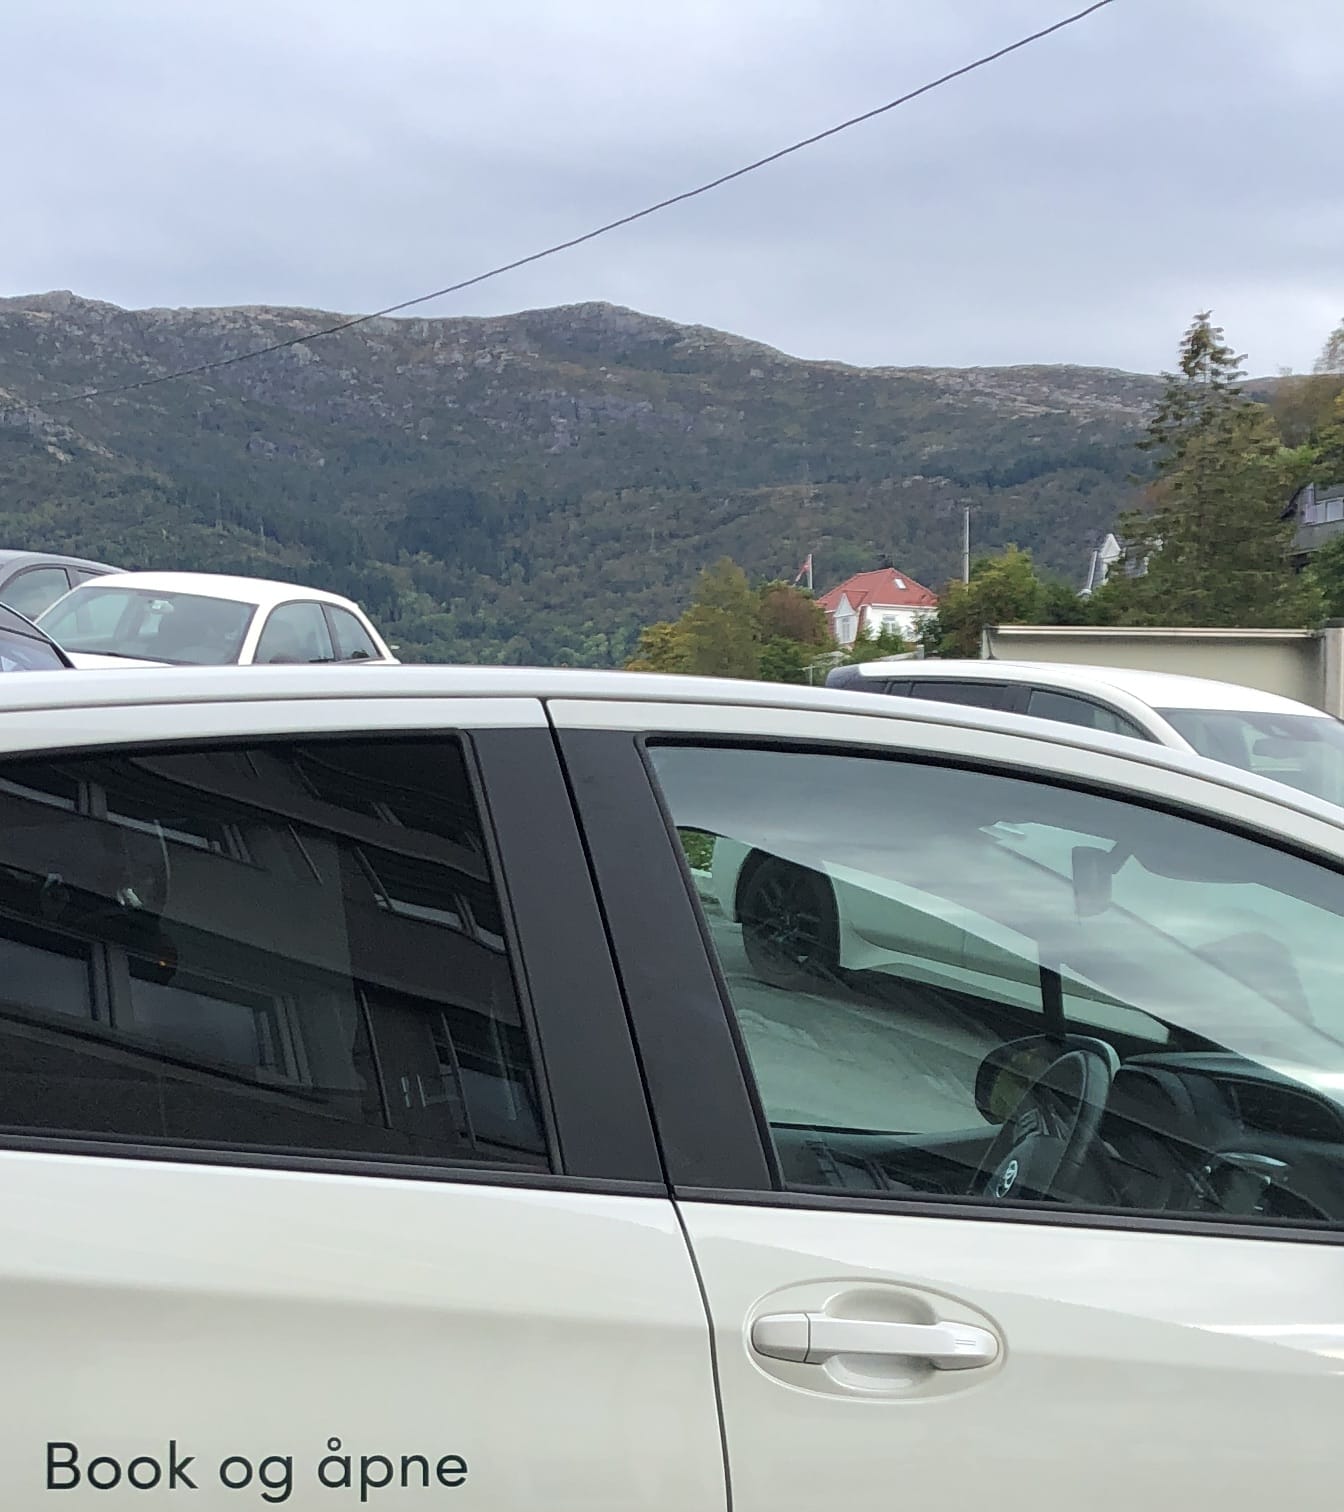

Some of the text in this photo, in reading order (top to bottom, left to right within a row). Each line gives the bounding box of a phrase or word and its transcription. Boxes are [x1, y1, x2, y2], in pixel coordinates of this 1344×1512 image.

[45, 1436, 469, 1504] Book og åpne
